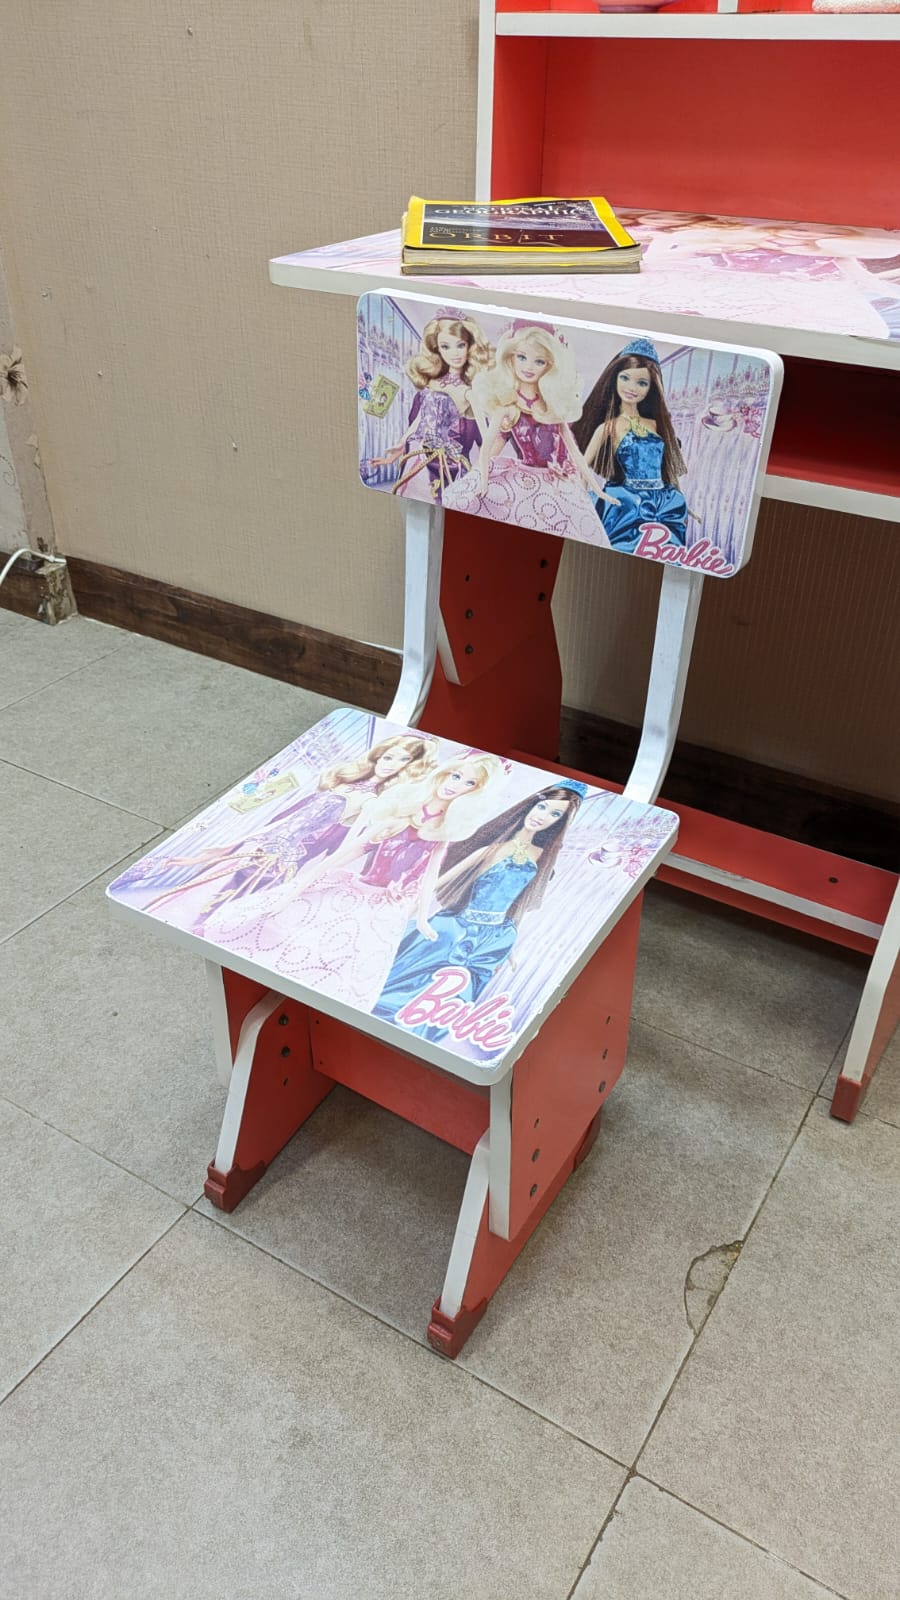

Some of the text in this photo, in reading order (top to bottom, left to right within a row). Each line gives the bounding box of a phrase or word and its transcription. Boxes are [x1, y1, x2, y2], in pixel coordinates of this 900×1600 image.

[429, 232, 565, 241] ORBIT
[635, 522, 733, 575] Barbie
[398, 968, 514, 1050] Barbie
